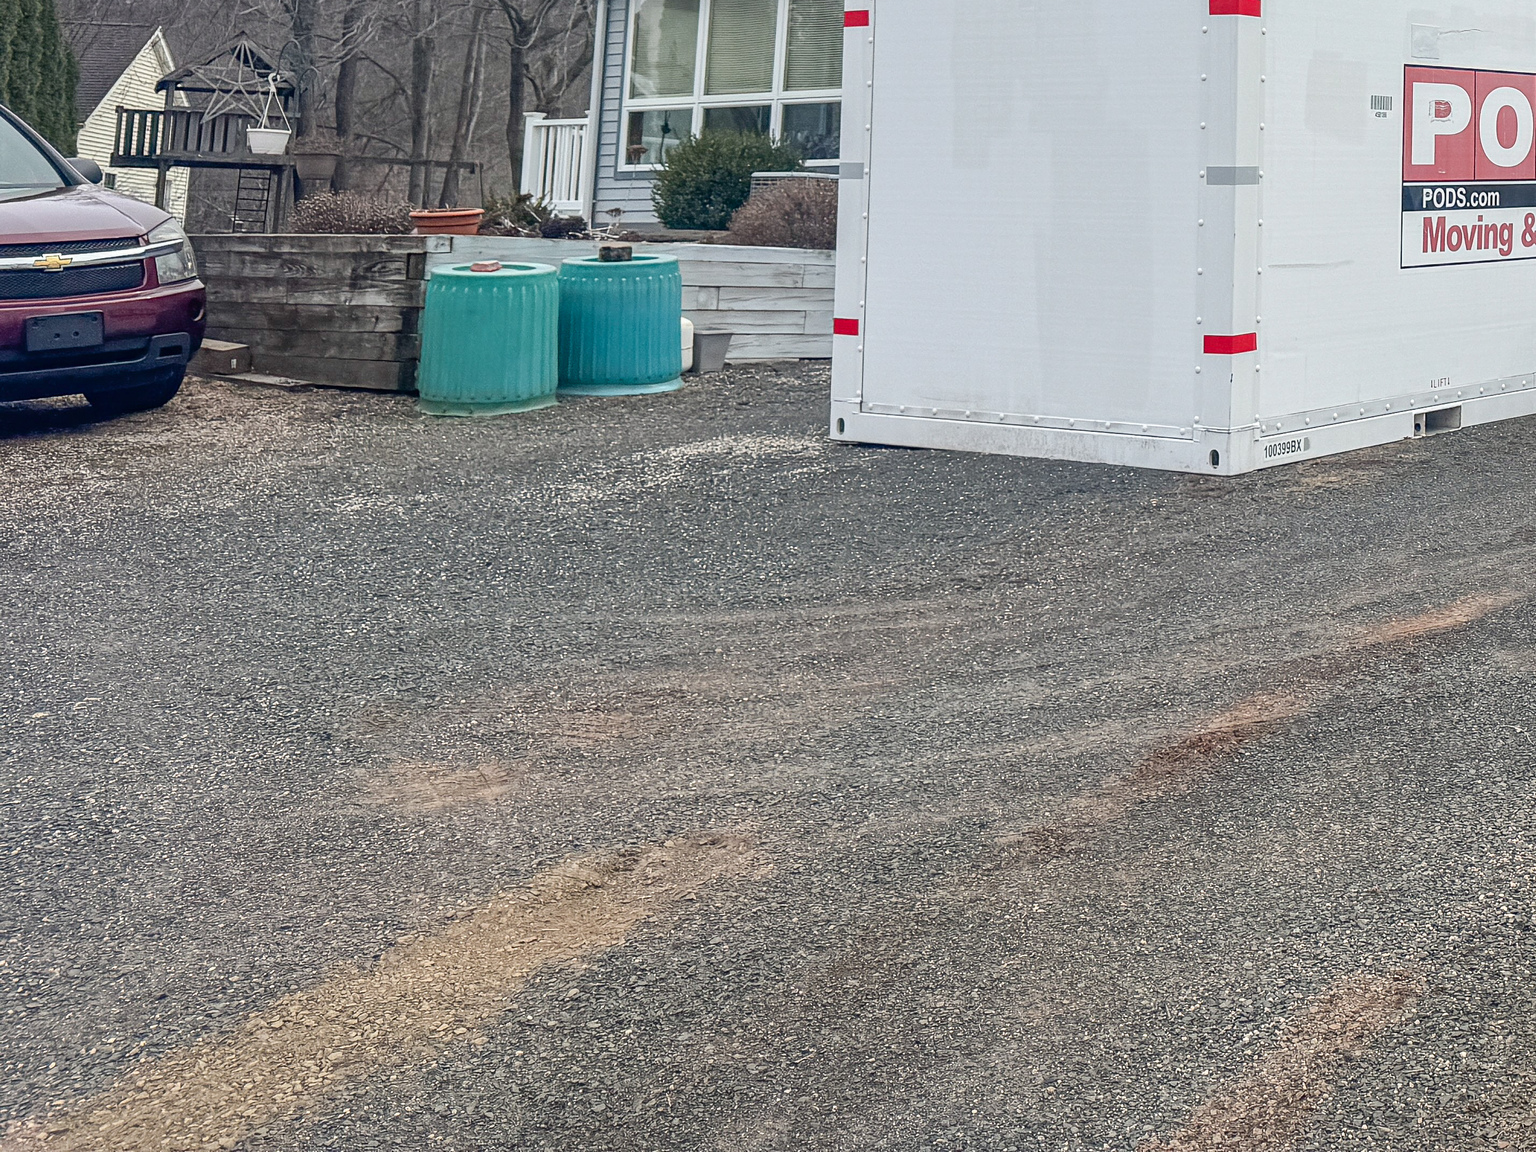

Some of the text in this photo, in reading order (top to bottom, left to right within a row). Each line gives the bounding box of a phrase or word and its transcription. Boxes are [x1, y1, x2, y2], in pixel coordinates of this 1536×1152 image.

[1422, 188, 1500, 209] PODS.com
[1422, 214, 1514, 256] Moving
[1264, 439, 1302, 459] 100399BX
